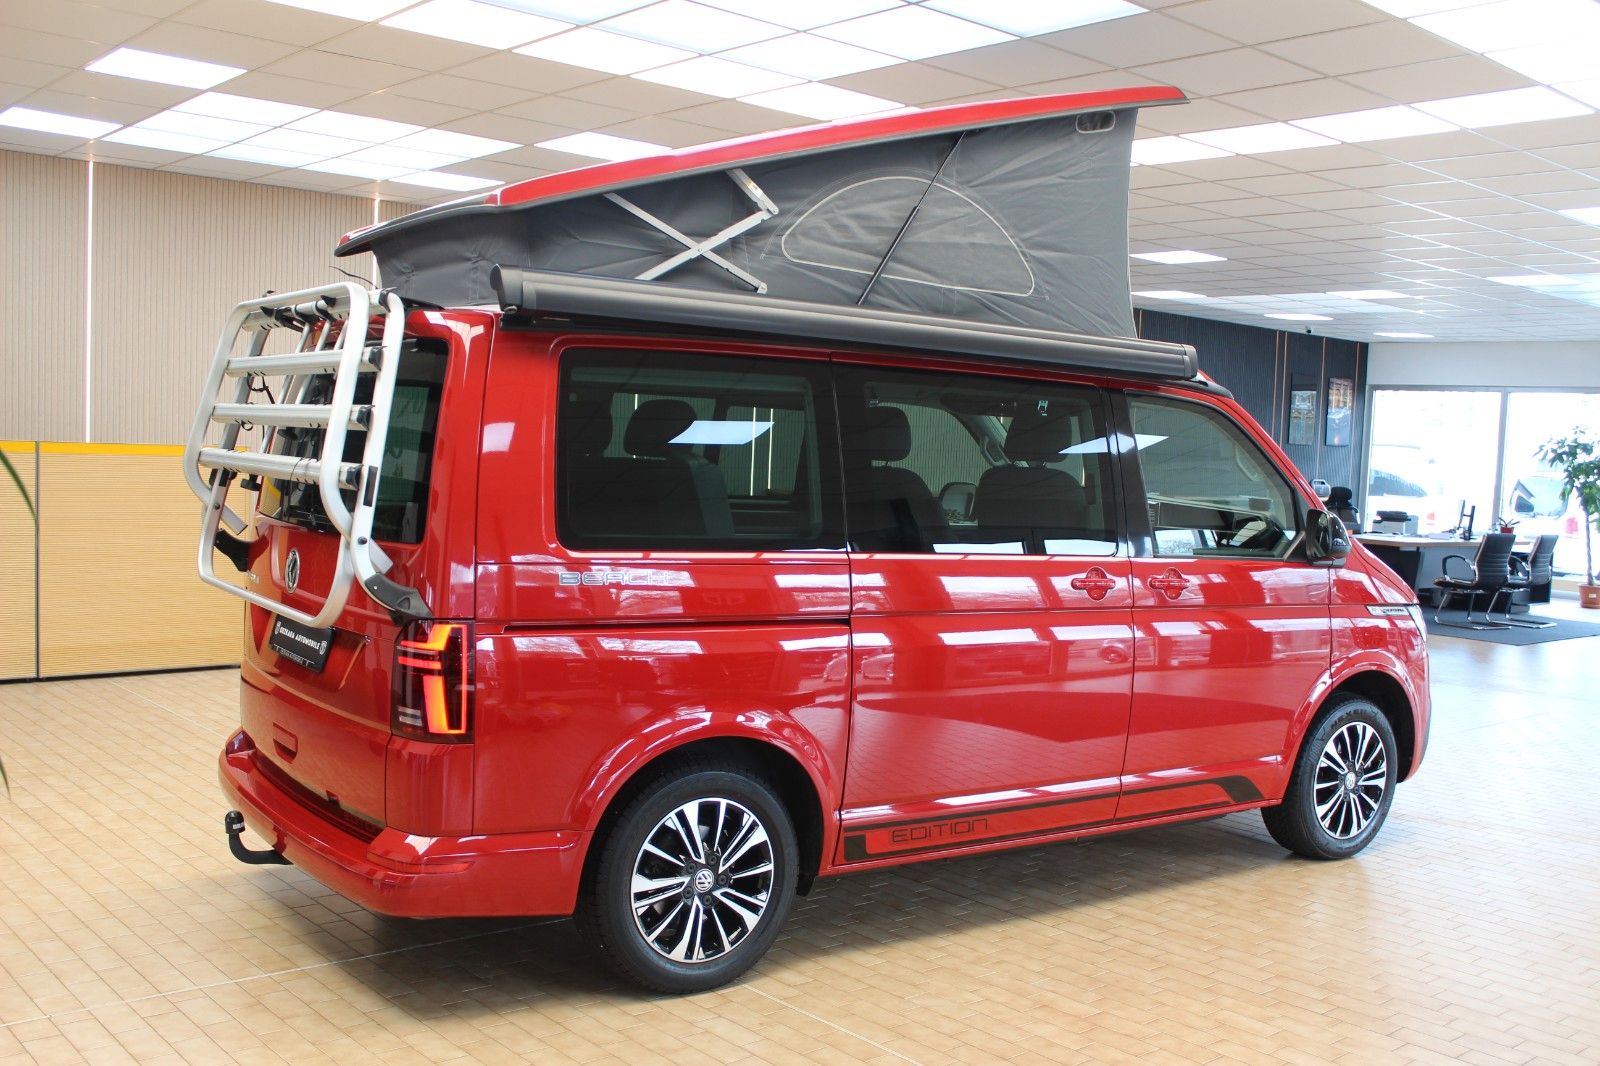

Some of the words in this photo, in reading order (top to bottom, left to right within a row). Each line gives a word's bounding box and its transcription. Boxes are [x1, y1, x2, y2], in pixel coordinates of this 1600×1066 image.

[558, 571, 669, 586] BEACH
[295, 634, 321, 650] AUTOMOBILE
[892, 818, 988, 843] EDITION
